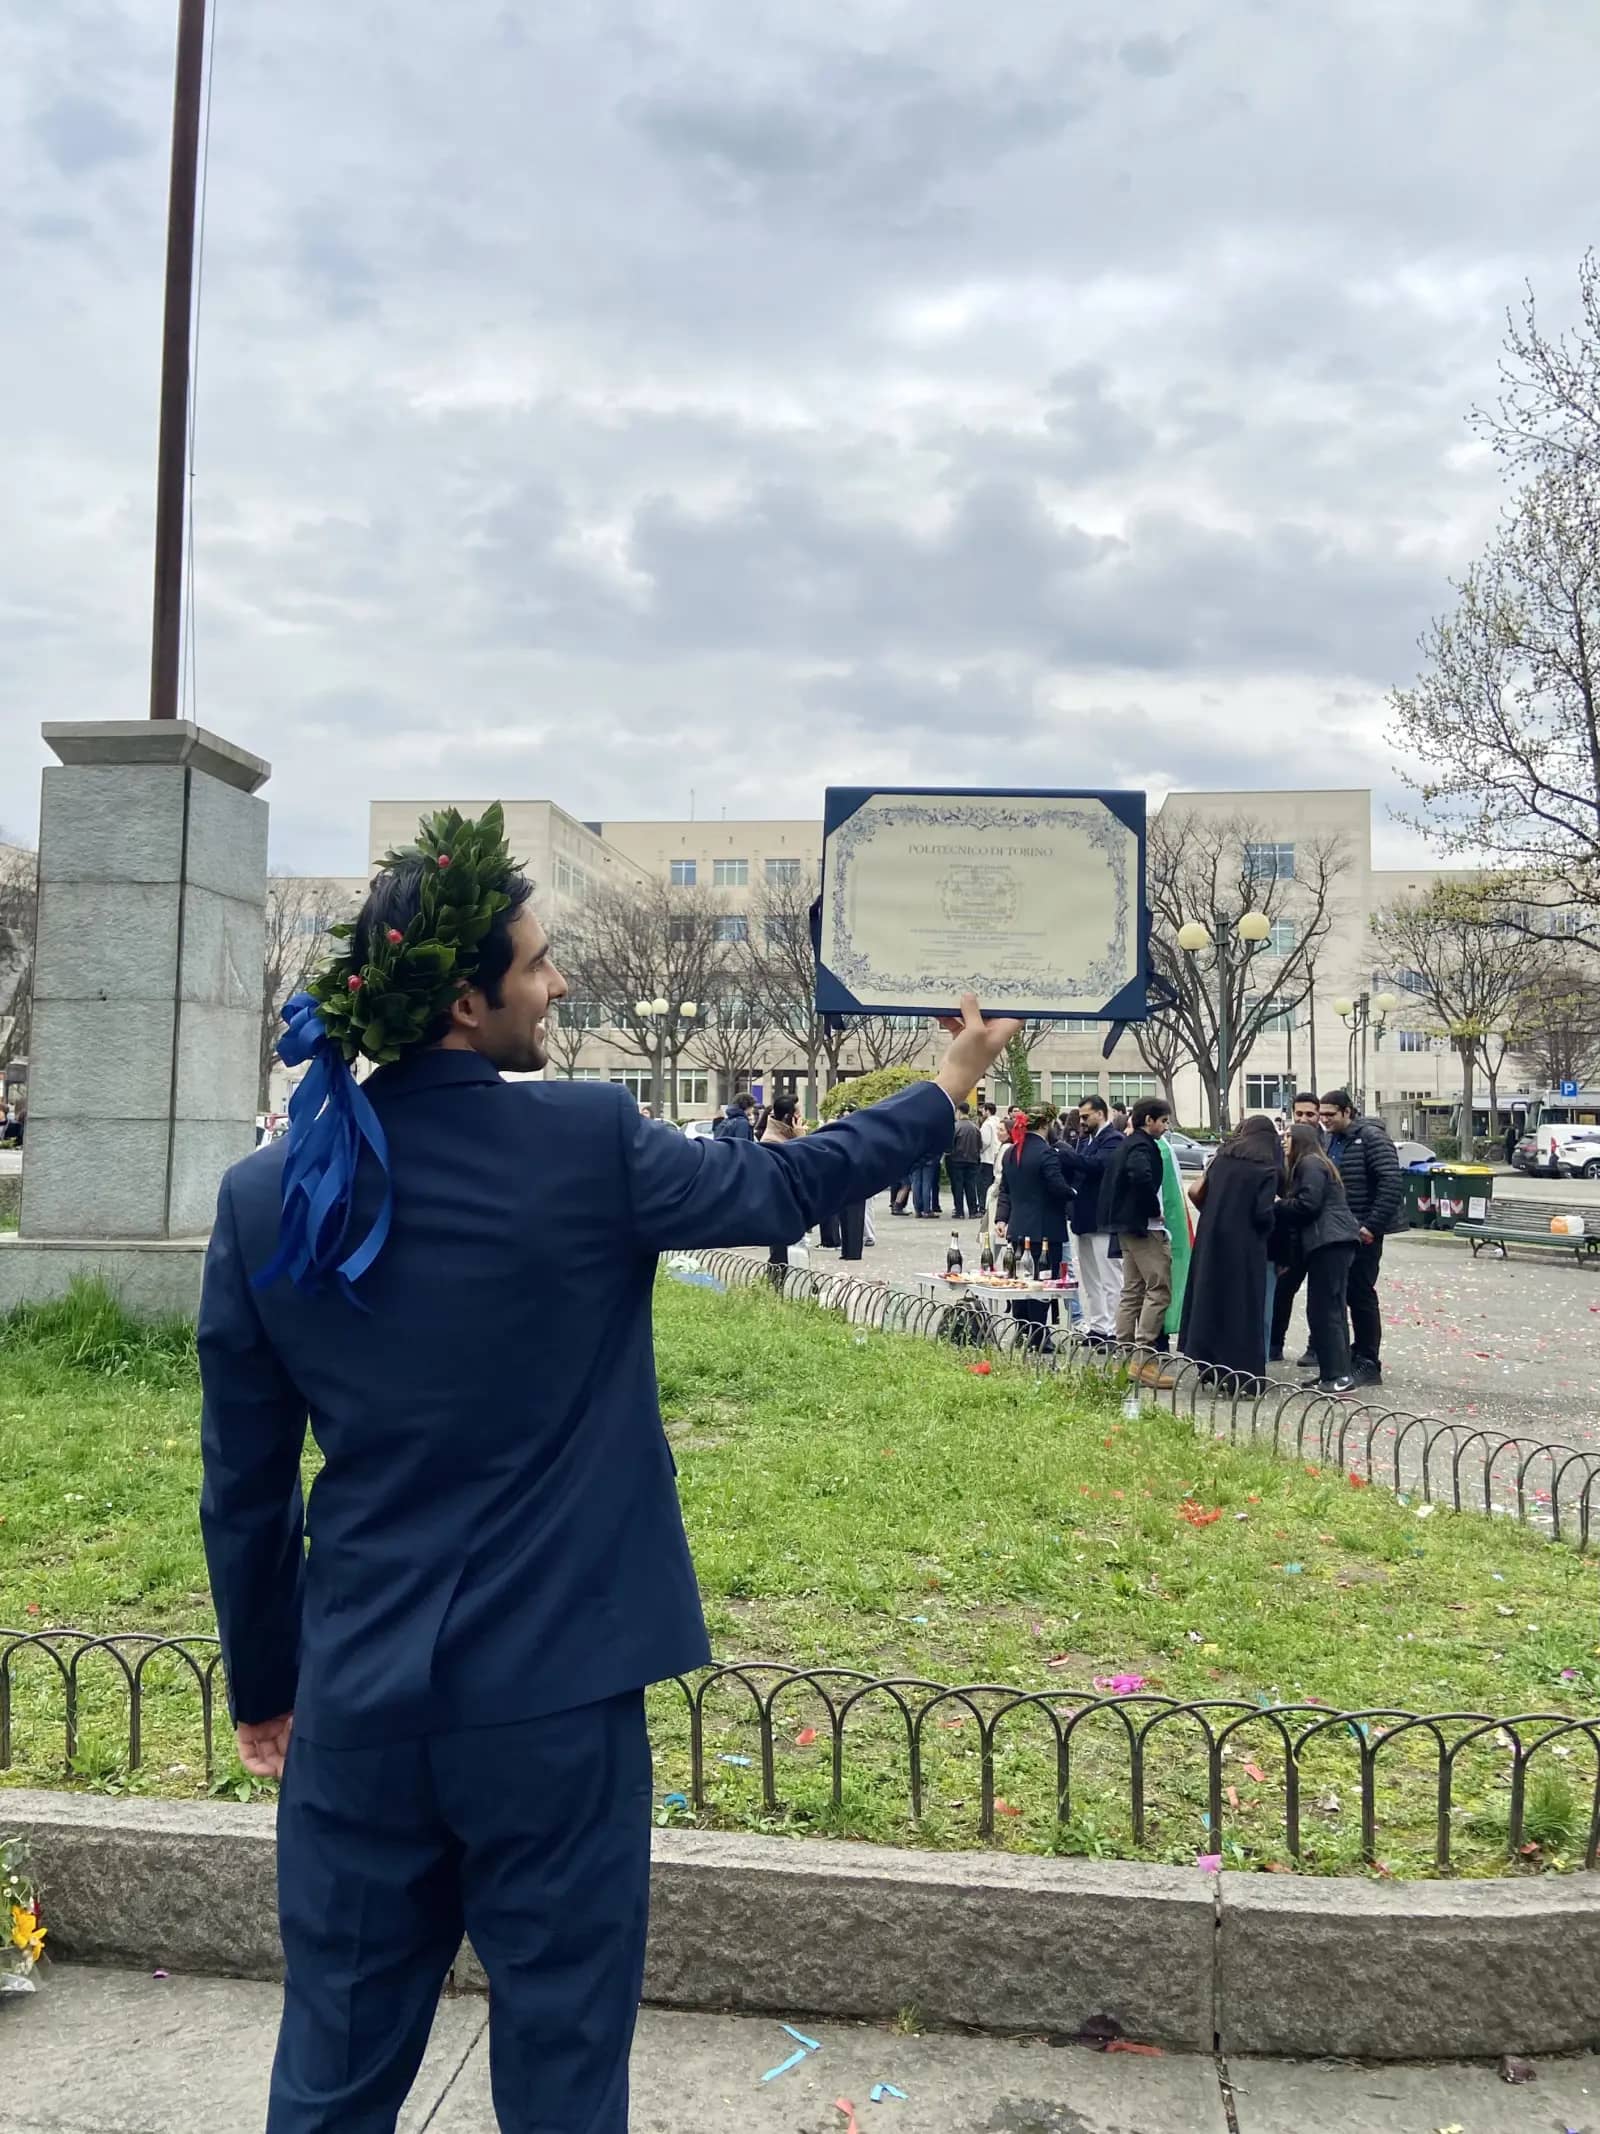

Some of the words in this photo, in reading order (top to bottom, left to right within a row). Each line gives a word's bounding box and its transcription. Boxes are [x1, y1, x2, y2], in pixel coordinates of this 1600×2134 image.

[908, 844, 989, 856] POLITECNICO
[990, 846, 1004, 857] DI
[1006, 847, 1054, 857] TORINO
[1563, 1082, 1575, 1096] P
